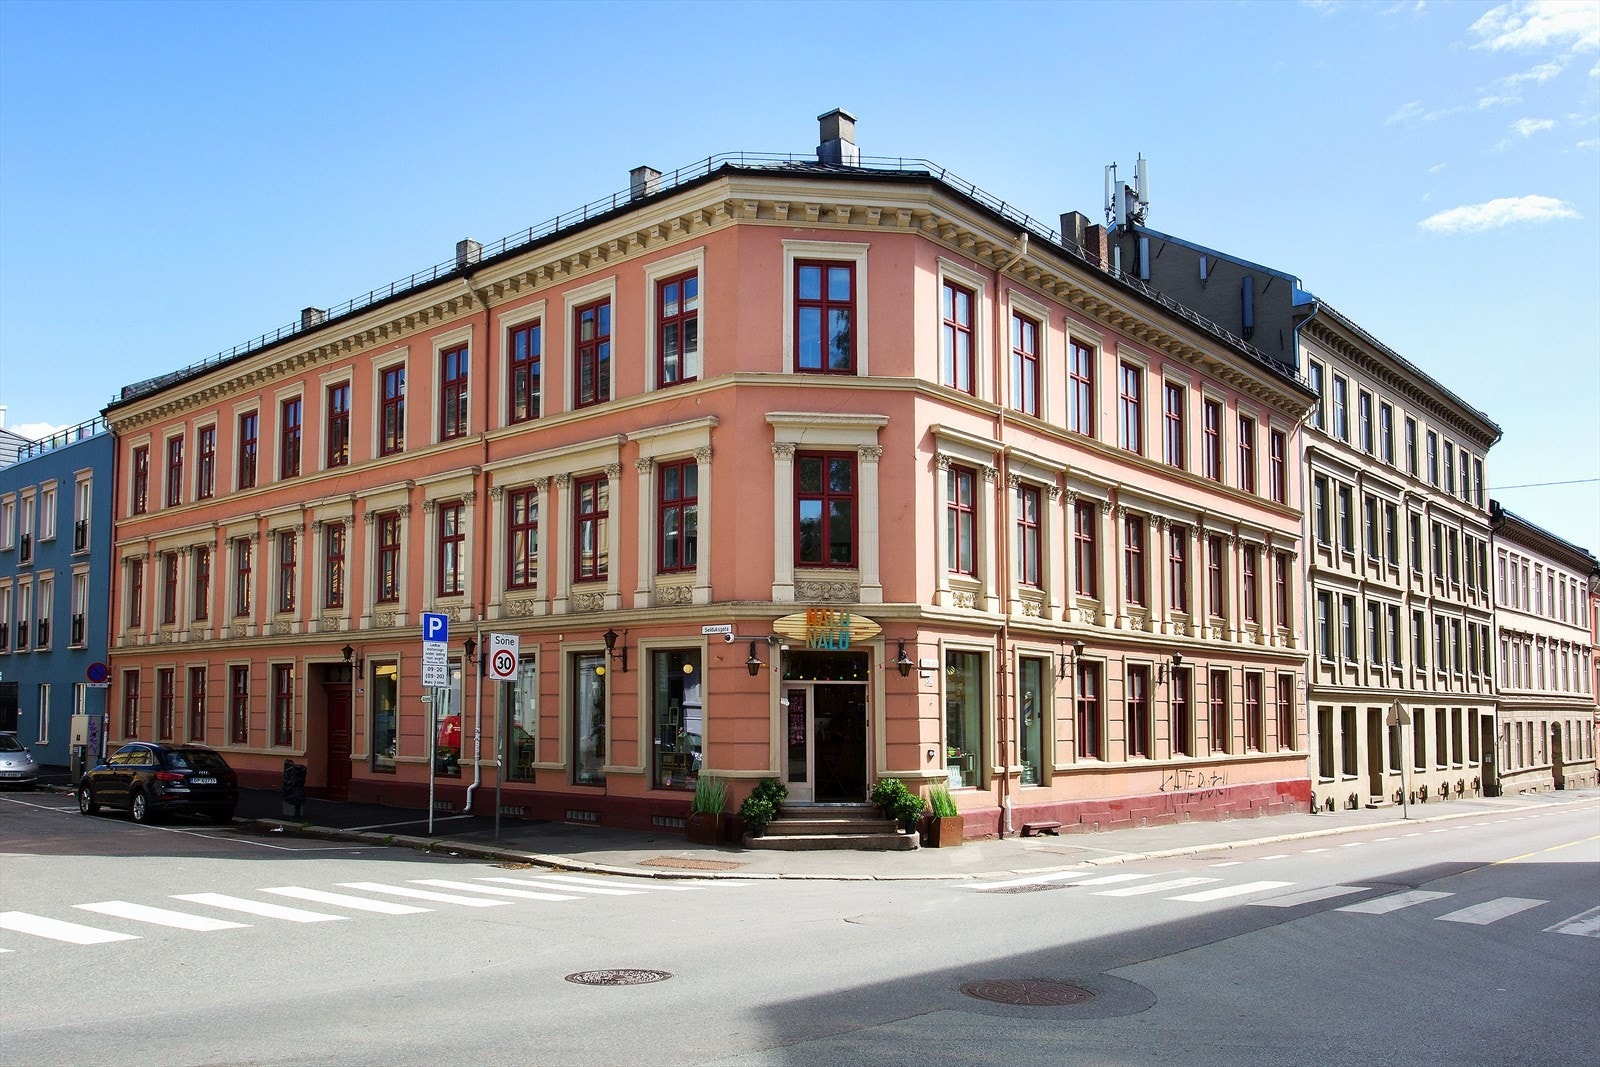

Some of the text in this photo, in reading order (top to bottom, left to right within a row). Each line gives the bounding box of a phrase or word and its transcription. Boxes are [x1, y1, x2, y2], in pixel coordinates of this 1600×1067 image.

[805, 607, 850, 627] NALU
[429, 617, 443, 638] P
[494, 635, 515, 646] Sone
[805, 628, 850, 650] NALU
[497, 656, 512, 670] 30
